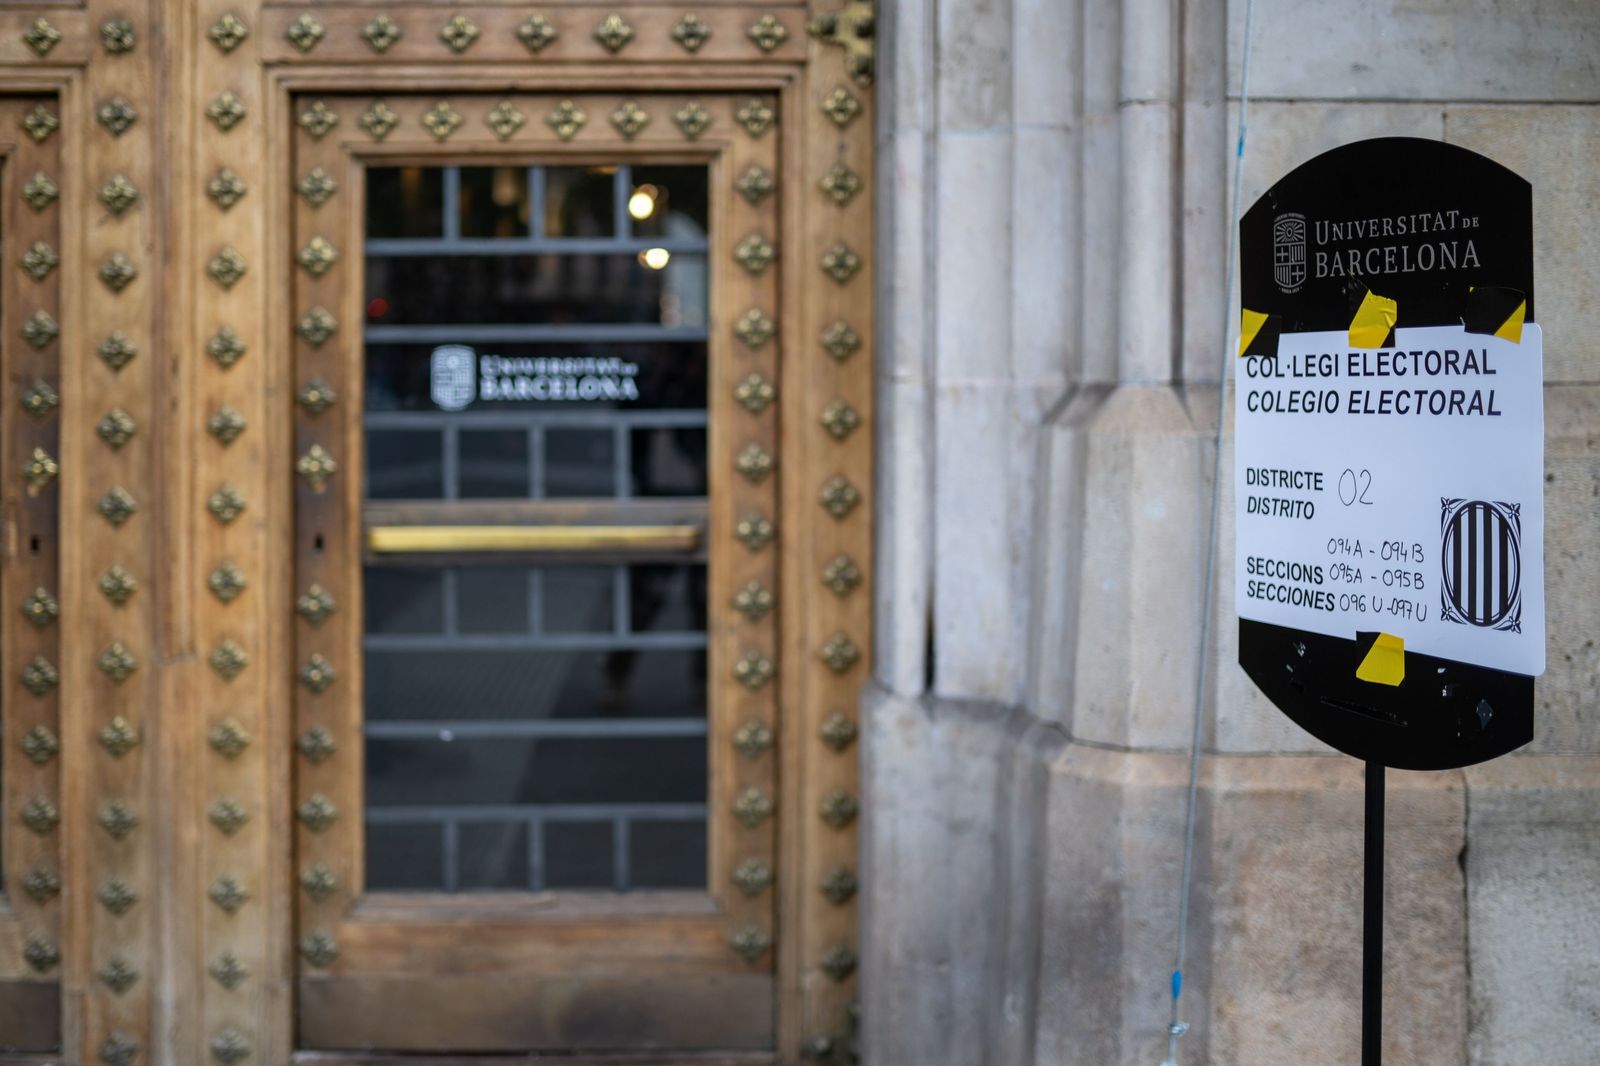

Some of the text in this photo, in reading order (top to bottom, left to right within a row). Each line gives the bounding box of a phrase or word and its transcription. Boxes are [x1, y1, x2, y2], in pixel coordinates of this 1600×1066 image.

[1315, 210, 1461, 246] UNIVERSITAT
[1462, 216, 1480, 229] DE
[1315, 239, 1481, 278] BARCELONA
[1347, 349, 1497, 377] ELECTORAL
[480, 375, 639, 400] BARCELONA
[1247, 389, 1502, 416] COLEGIO ELECTORAL
[1246, 467, 1324, 492] DISTRICTE
[1337, 468, 1374, 507] 02
[1247, 496, 1315, 520] DISTRITO
[1246, 556, 1324, 585] SECCIONS
[1247, 580, 1335, 612] SECCIONES
